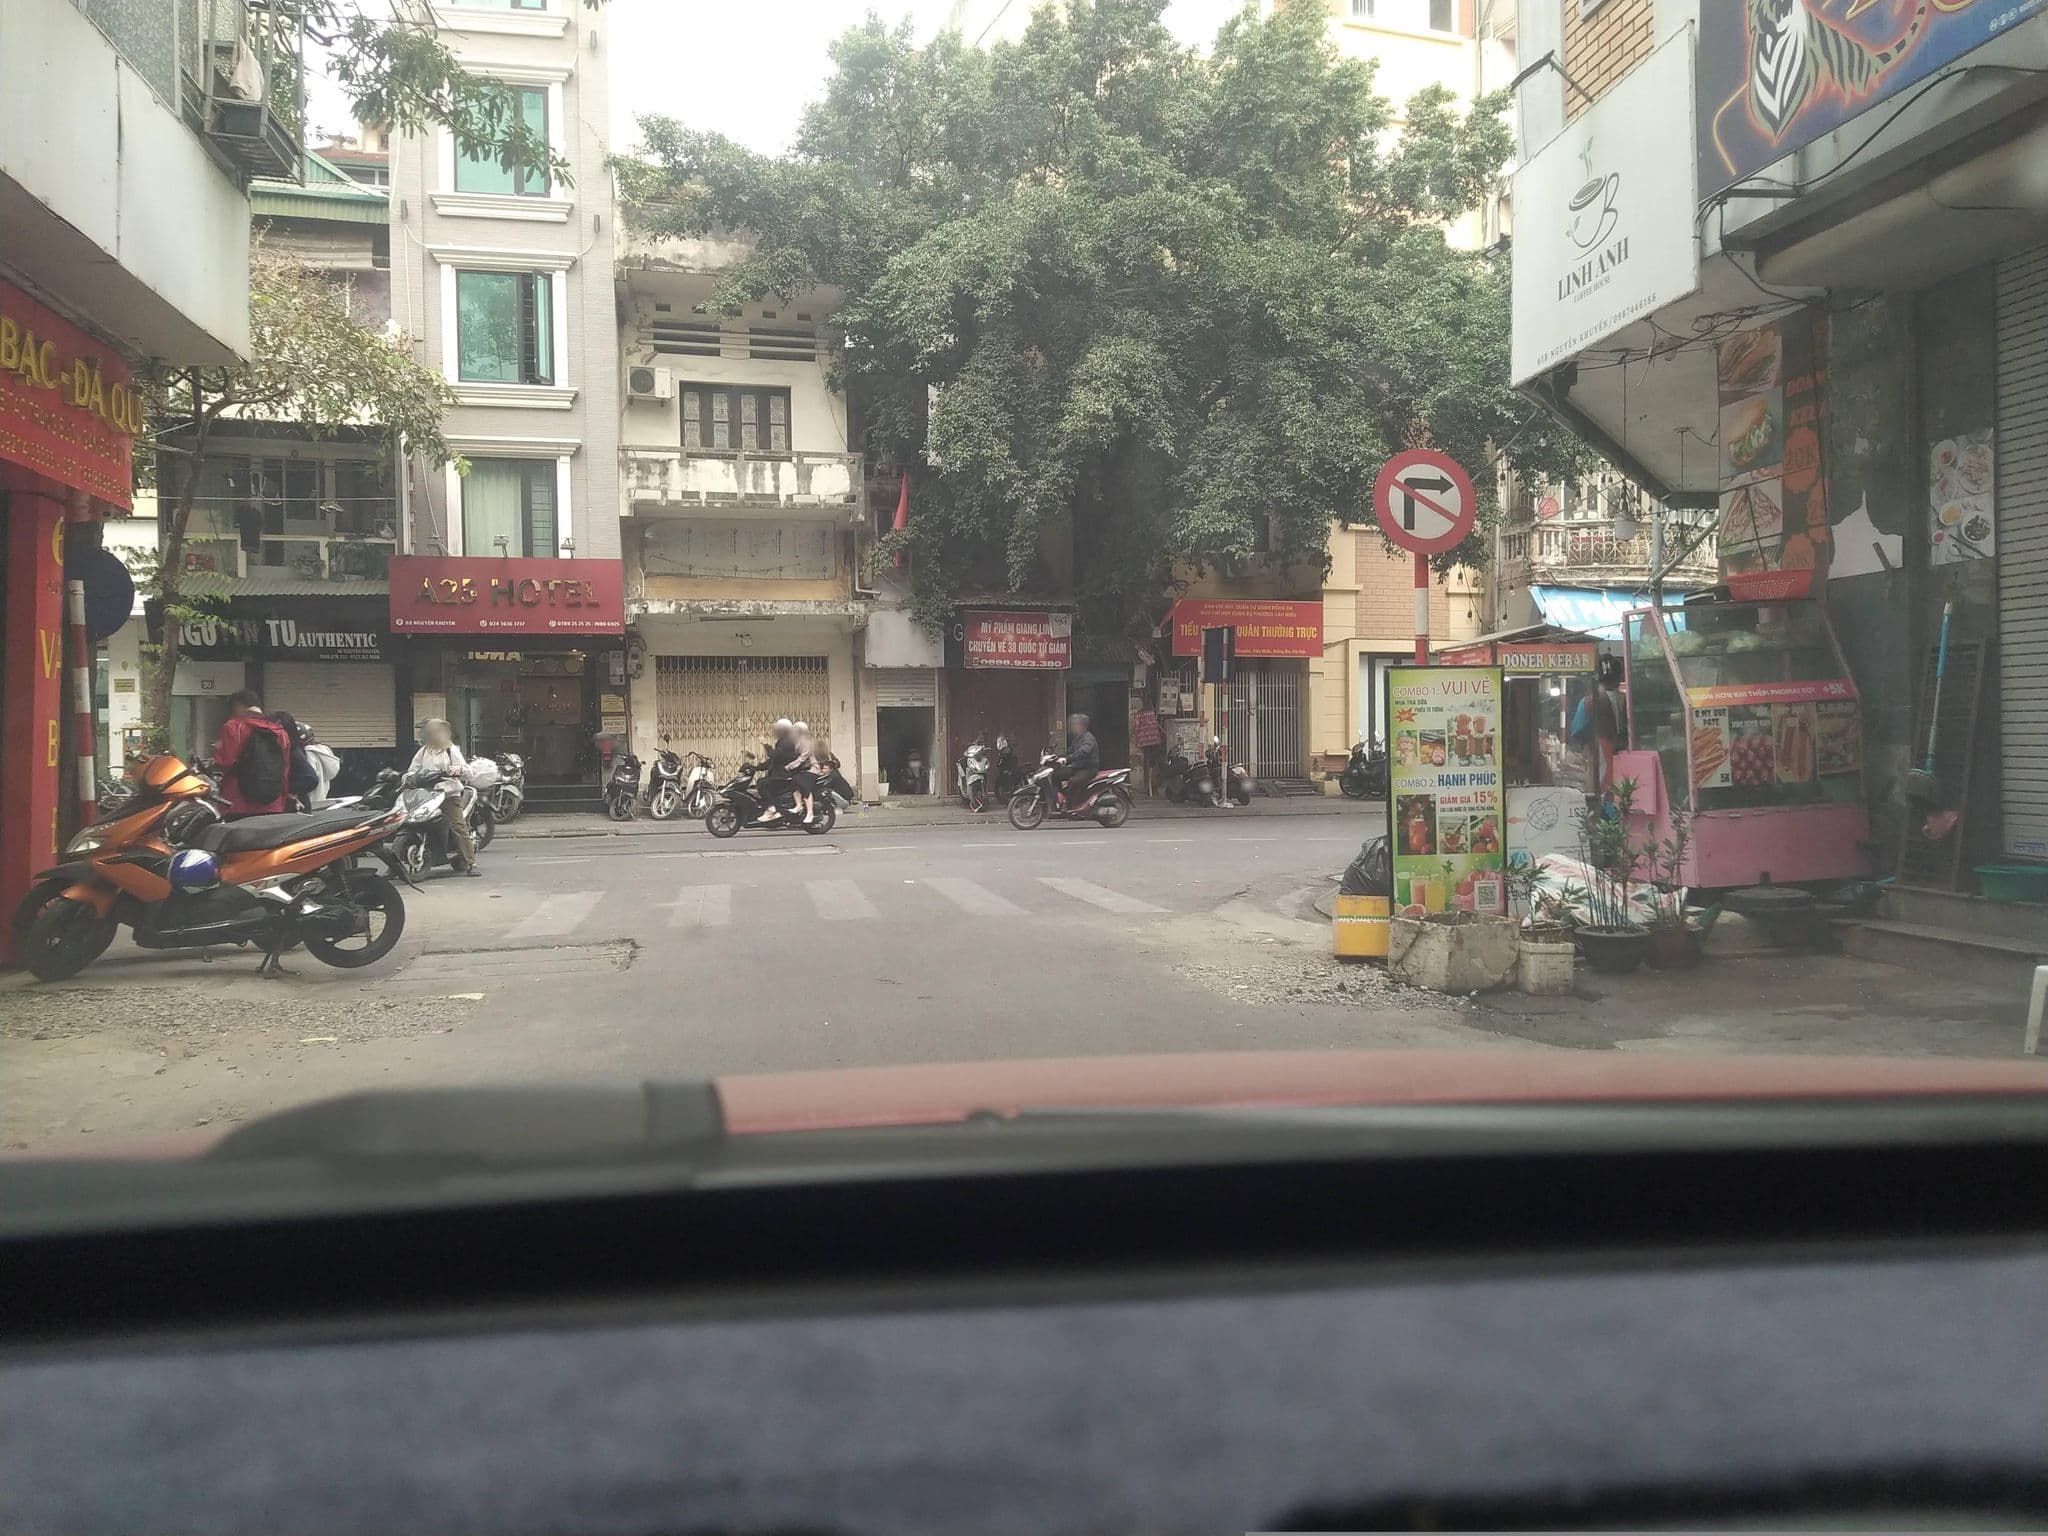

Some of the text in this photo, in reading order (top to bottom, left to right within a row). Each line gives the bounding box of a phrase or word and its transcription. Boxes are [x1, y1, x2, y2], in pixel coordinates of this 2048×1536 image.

[1558, 236, 1629, 301] LINH ANH
[416, 577, 600, 608] A25 HOTEL
[1015, 623, 1038, 635] GIANG
[1236, 624, 1260, 638] QUÂN
[1261, 622, 1294, 638] THƯỜNG
[1296, 626, 1318, 640] TRỰC
[298, 632, 378, 647] AUTHENTIC
[1007, 642, 1017, 653] 38
[1502, 650, 1544, 668] DÖNER
[1393, 686, 1429, 697] COMBO
[1441, 680, 1468, 695] VUI
[1471, 676, 1490, 694] VẺ
[1395, 778, 1427, 788] COMBO
[1438, 773, 1466, 790] HẠNH
[1469, 771, 1497, 786] PHÚC
[1473, 791, 1498, 804] 15%
